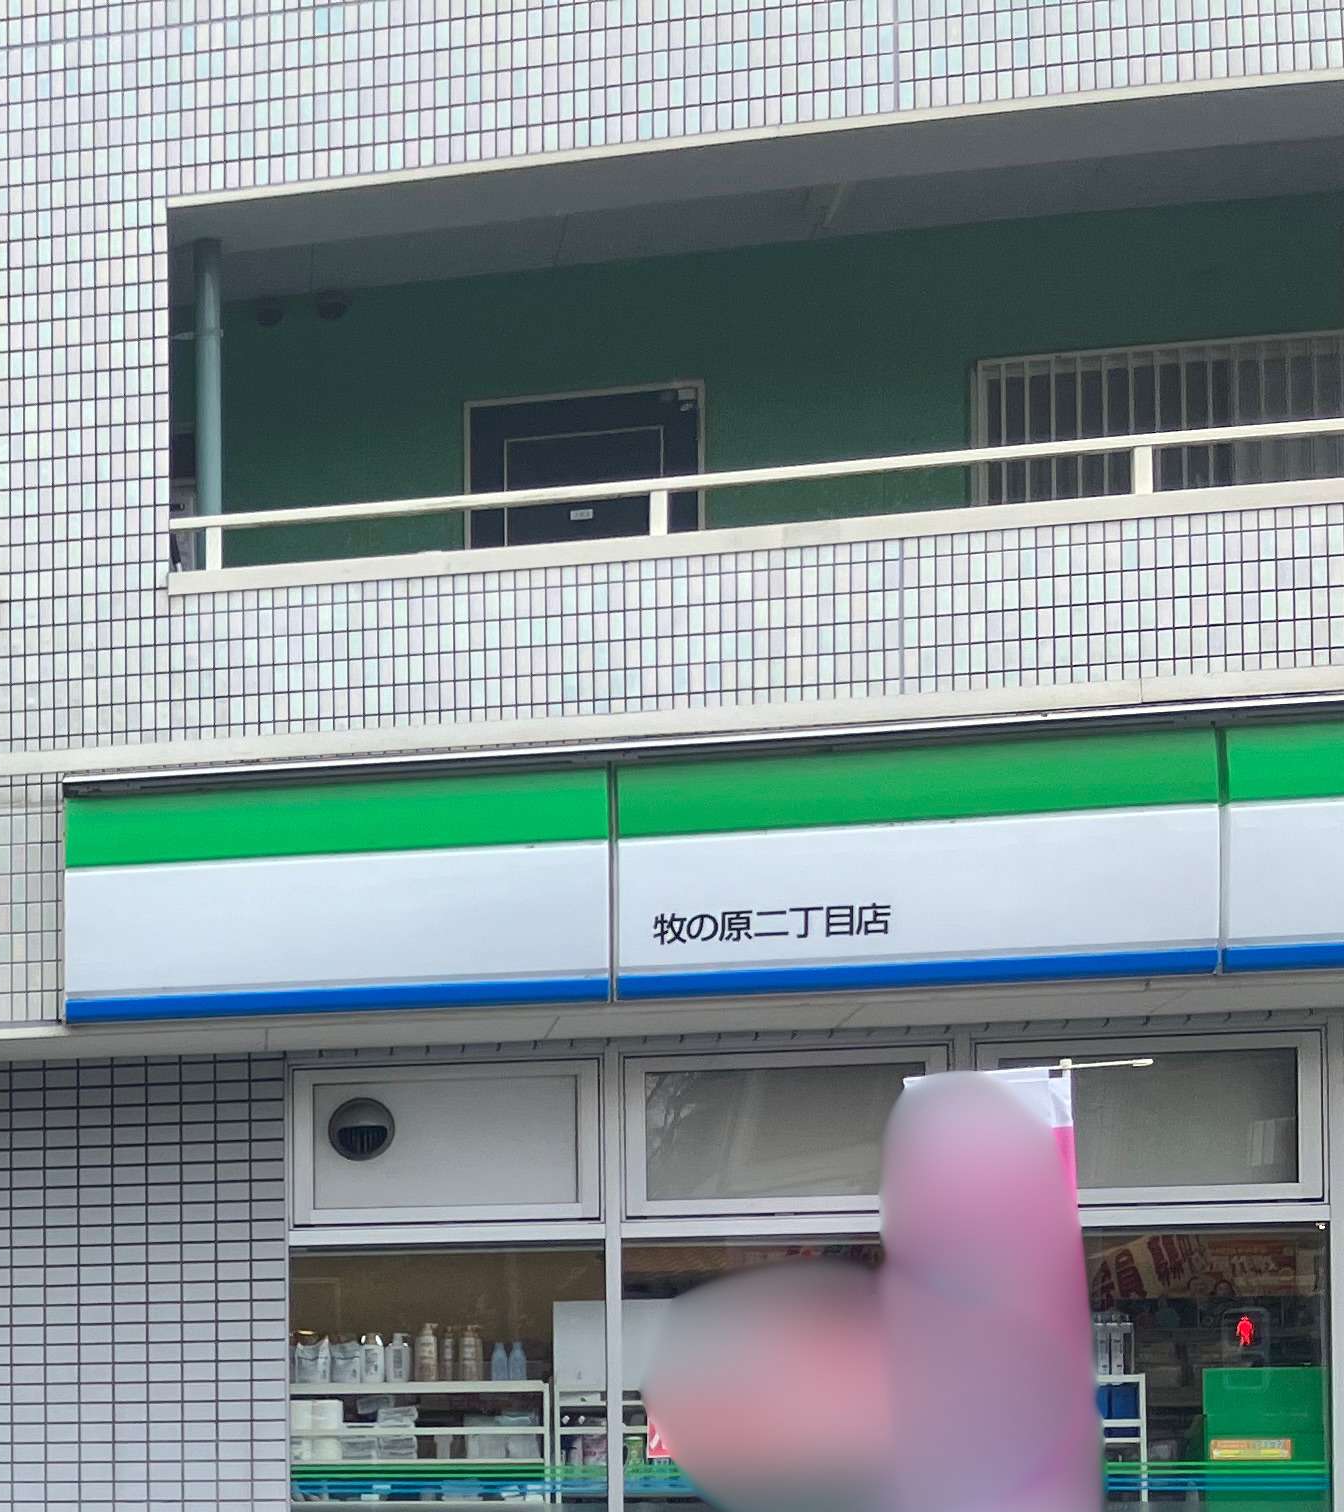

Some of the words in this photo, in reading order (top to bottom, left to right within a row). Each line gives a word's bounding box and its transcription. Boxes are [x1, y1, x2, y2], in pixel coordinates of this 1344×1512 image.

[653, 903, 891, 945] 牧の原二丁目店
